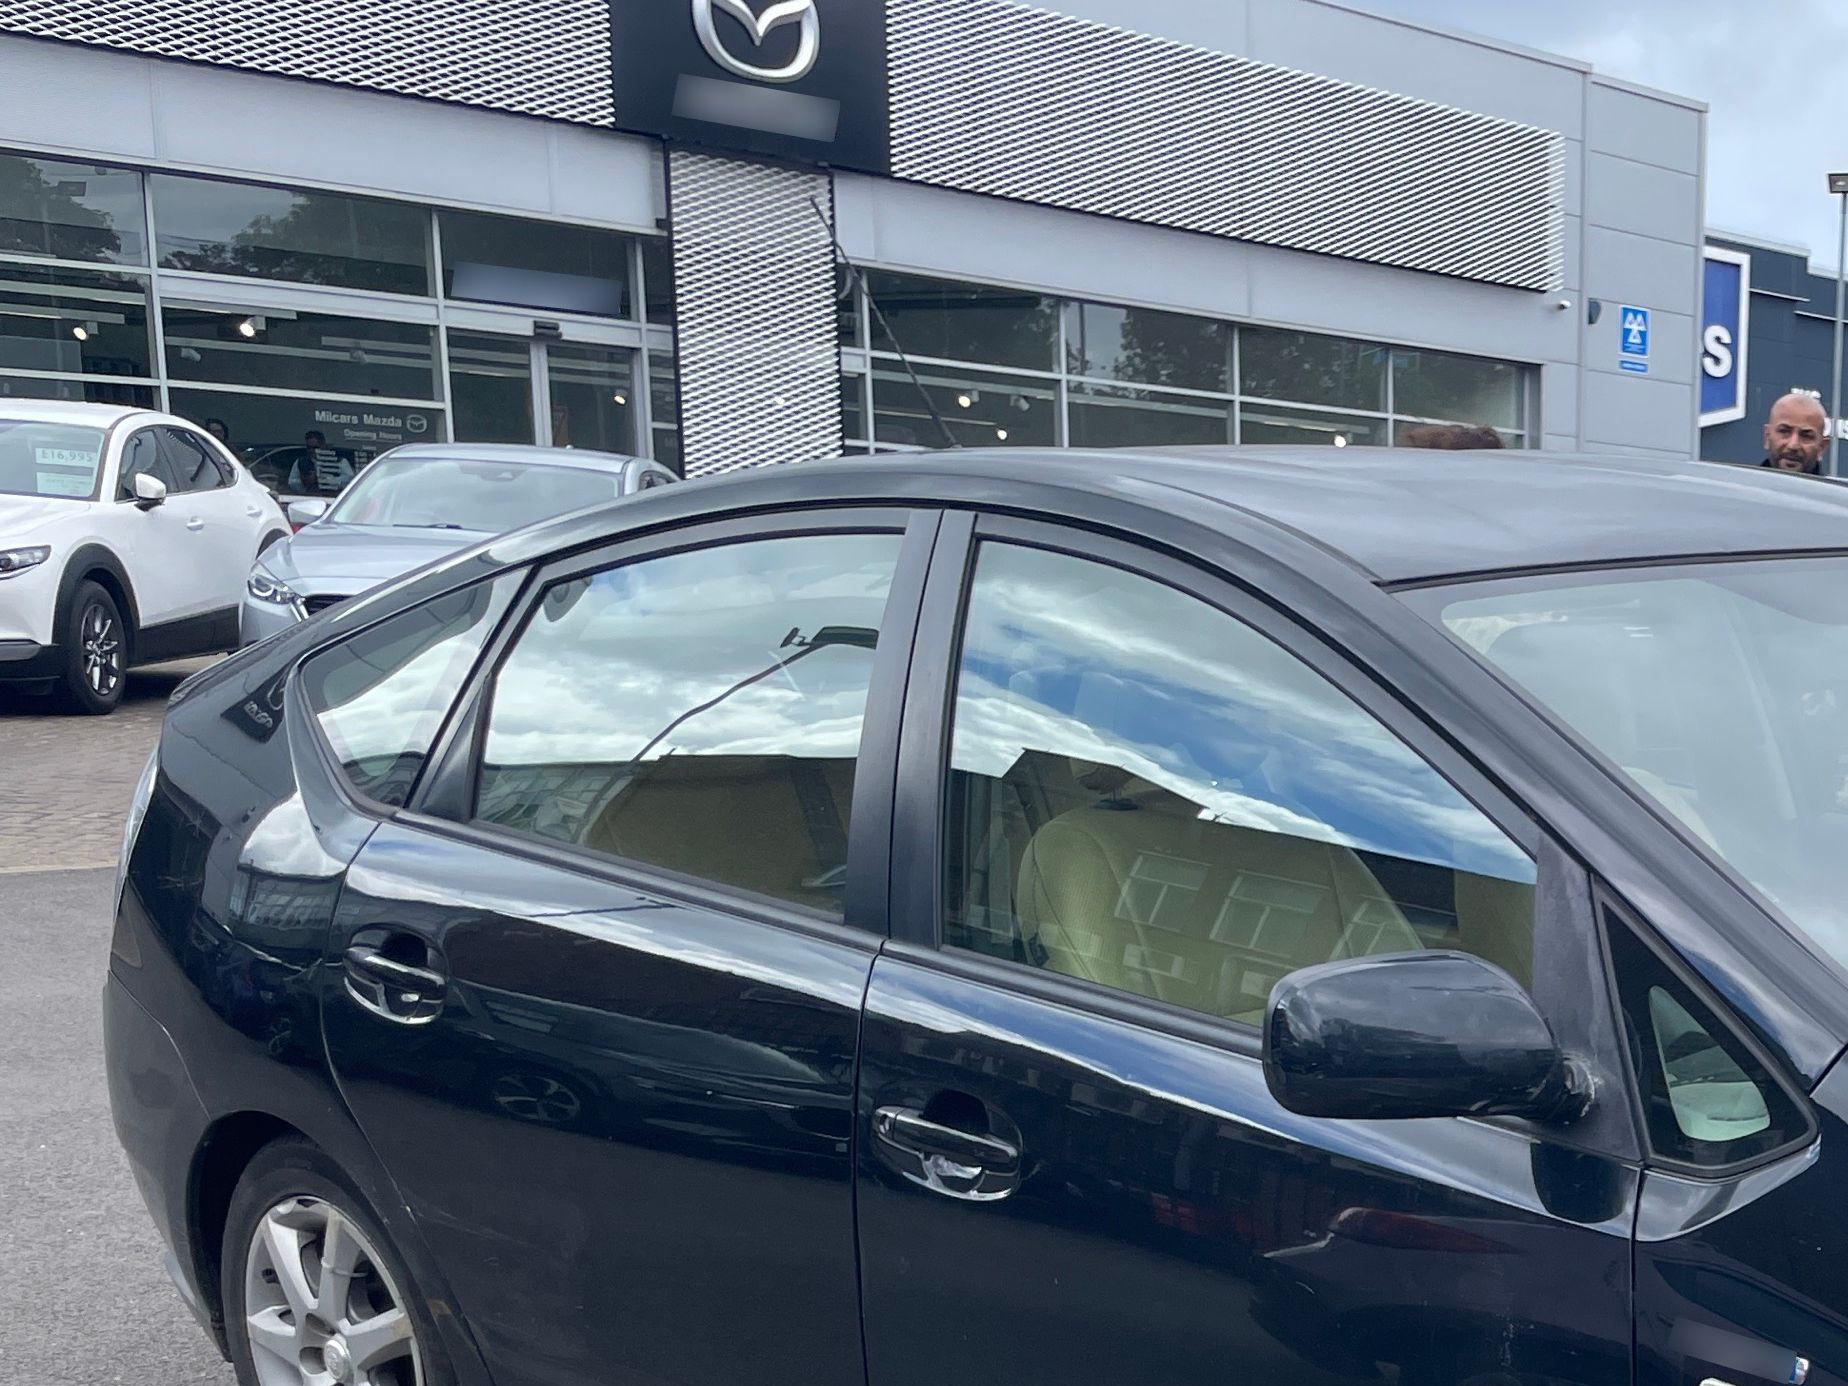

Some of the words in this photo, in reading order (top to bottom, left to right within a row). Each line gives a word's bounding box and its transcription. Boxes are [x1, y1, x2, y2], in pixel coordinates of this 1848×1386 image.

[1702, 324, 1733, 378] S
[315, 410, 359, 425] Milcars
[363, 414, 402, 428] Mazda
